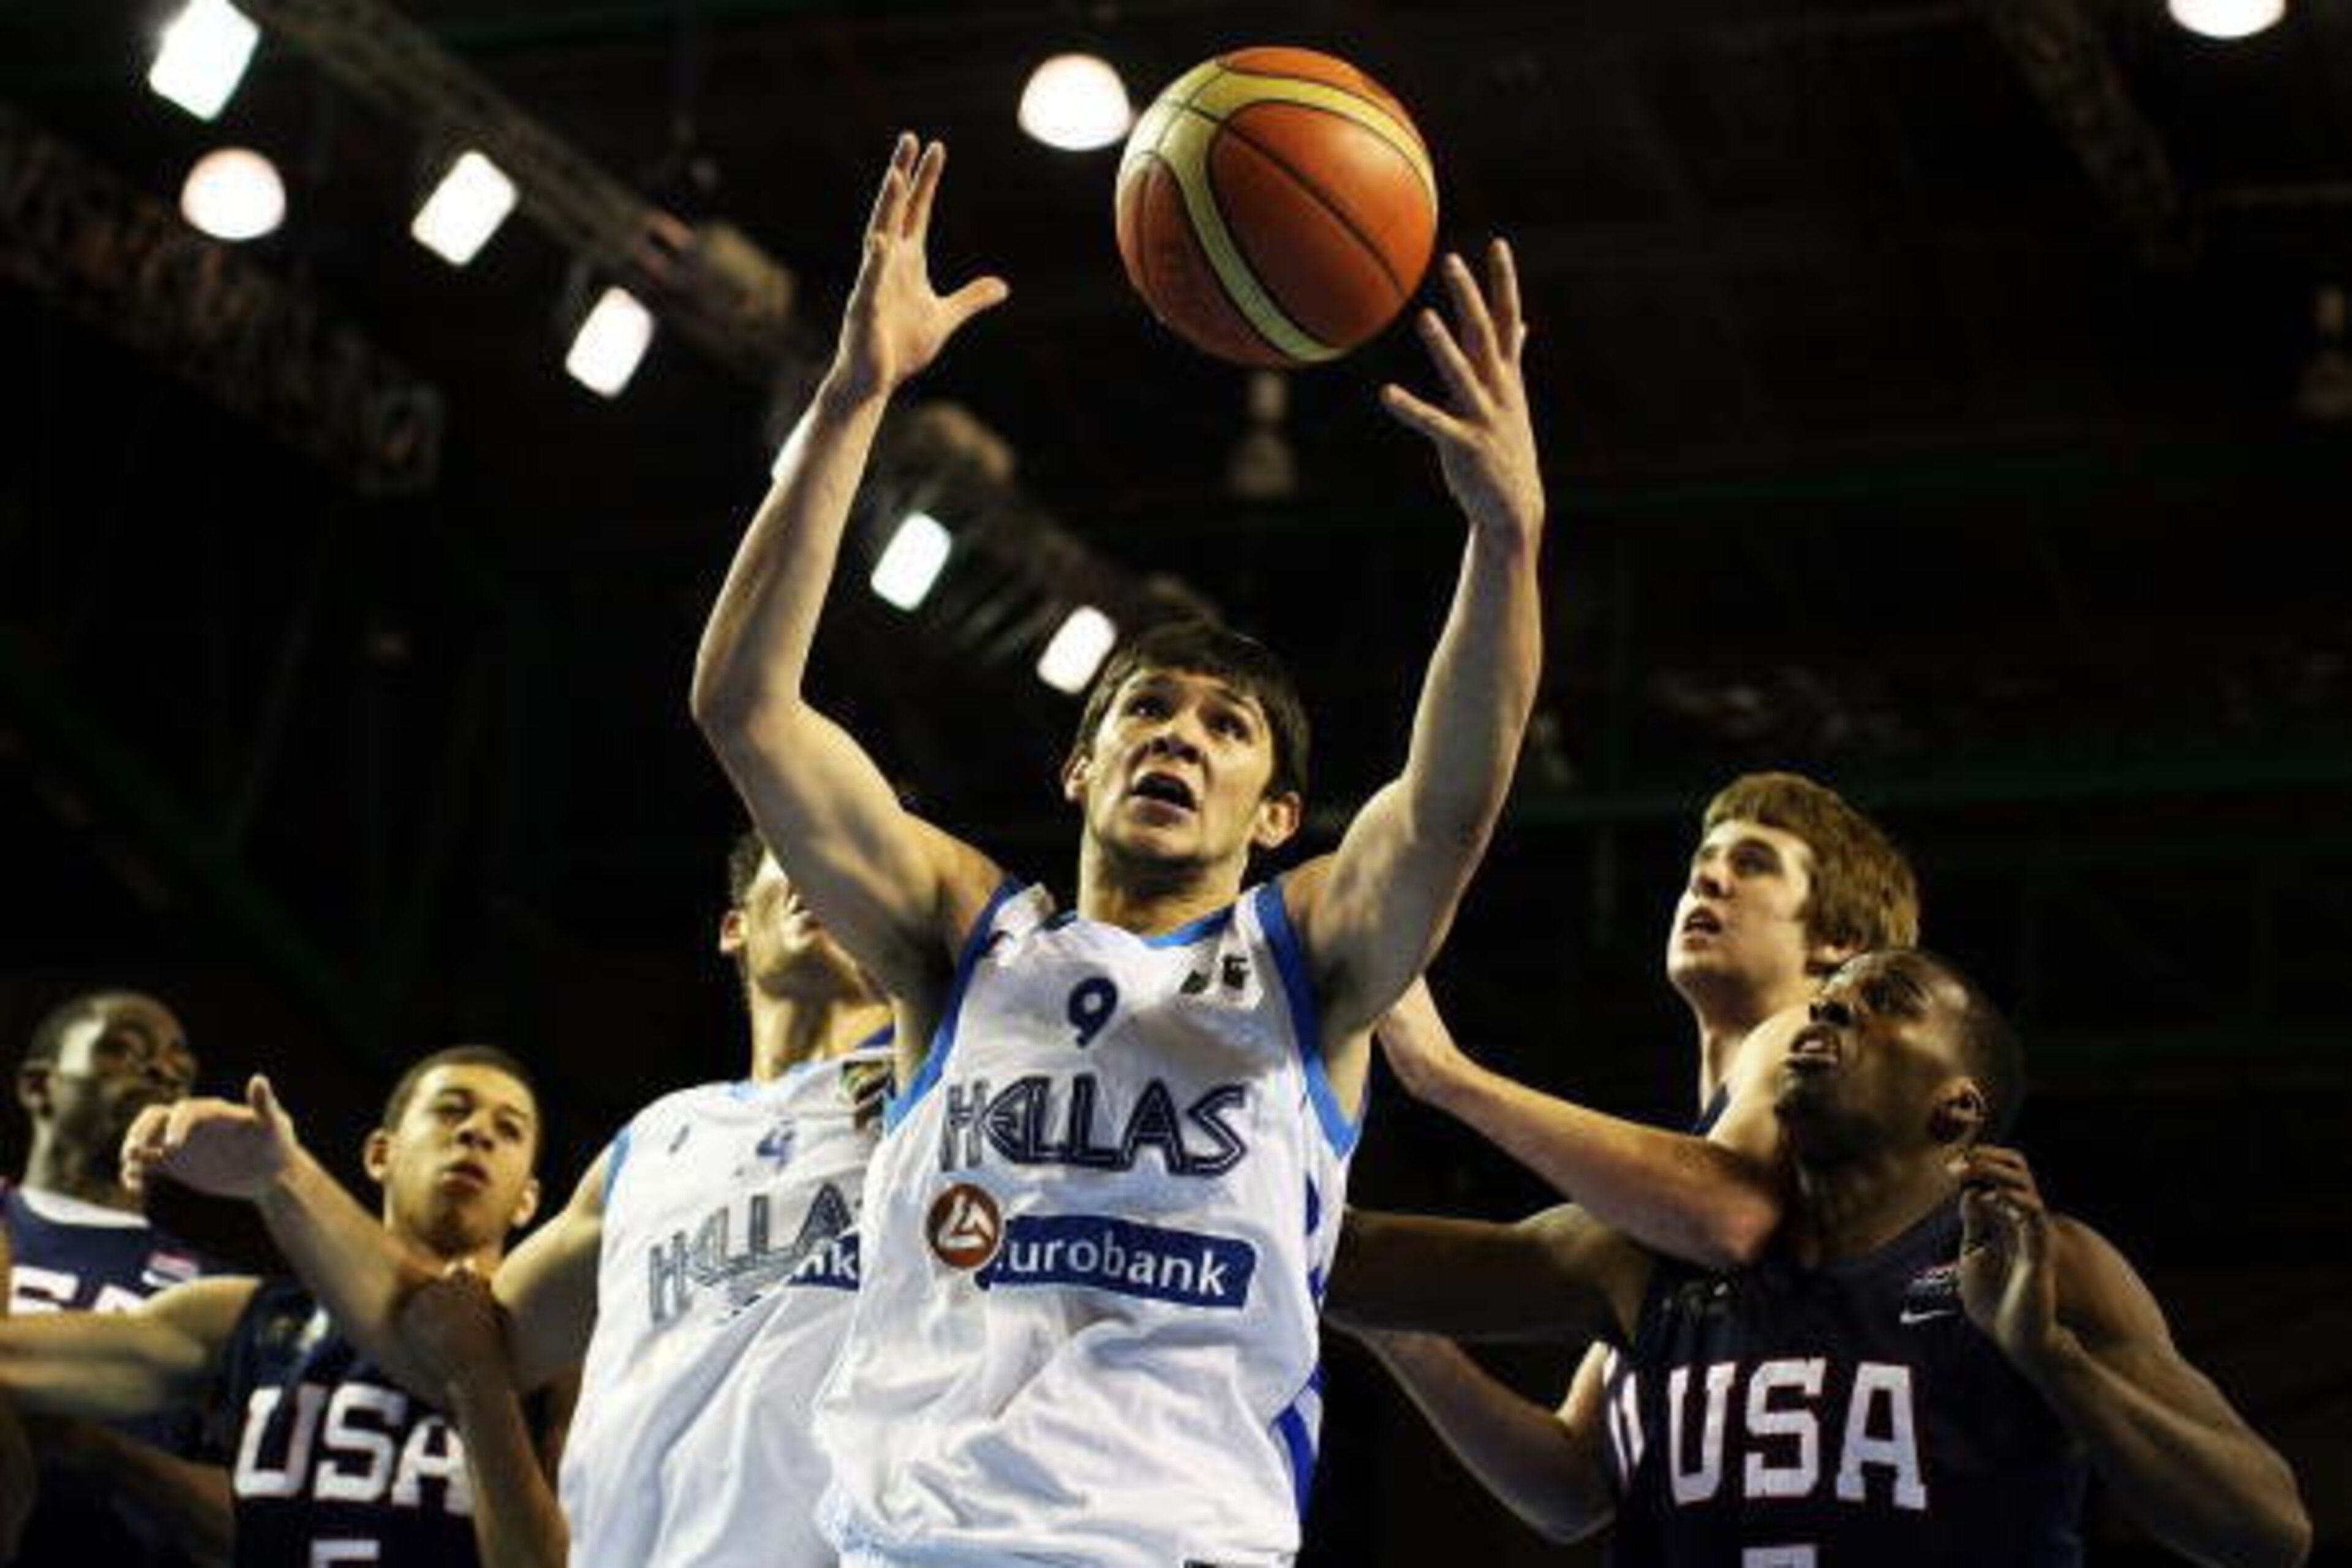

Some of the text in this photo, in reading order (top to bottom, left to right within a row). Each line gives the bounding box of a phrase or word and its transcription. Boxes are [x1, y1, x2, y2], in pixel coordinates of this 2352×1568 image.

[1068, 977, 1117, 1046] 9
[939, 1074, 1246, 1175] HELLAS
[995, 1230, 1227, 1296] urobank
[233, 1382, 475, 1514] USA
[1667, 1357, 1927, 1510] USA
